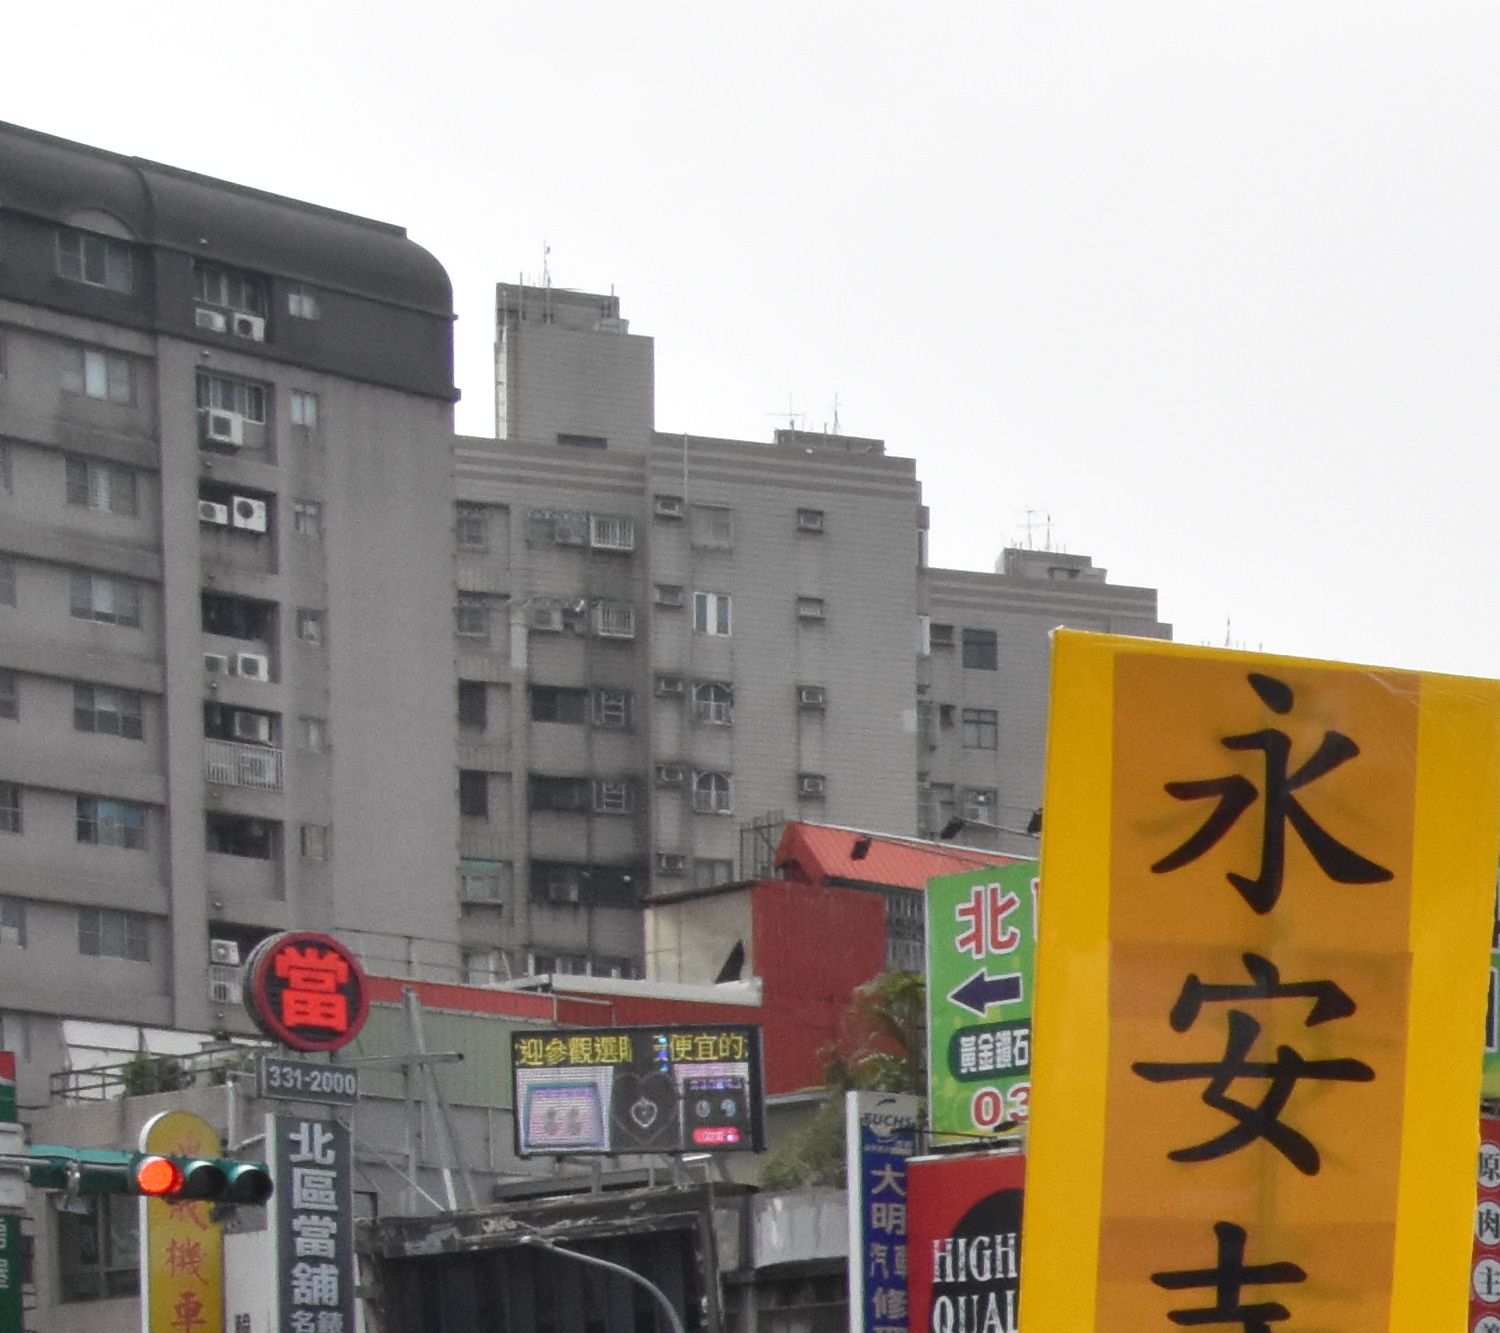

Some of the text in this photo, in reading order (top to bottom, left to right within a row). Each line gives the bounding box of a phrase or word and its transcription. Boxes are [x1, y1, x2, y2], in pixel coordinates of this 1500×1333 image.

[955, 882, 1038, 962] 北
[274, 946, 351, 1032] 當
[515, 1035, 633, 1066] 迎參觀選
[268, 1065, 357, 1095] 331-2000
[932, 1233, 1017, 1284] HIGH
